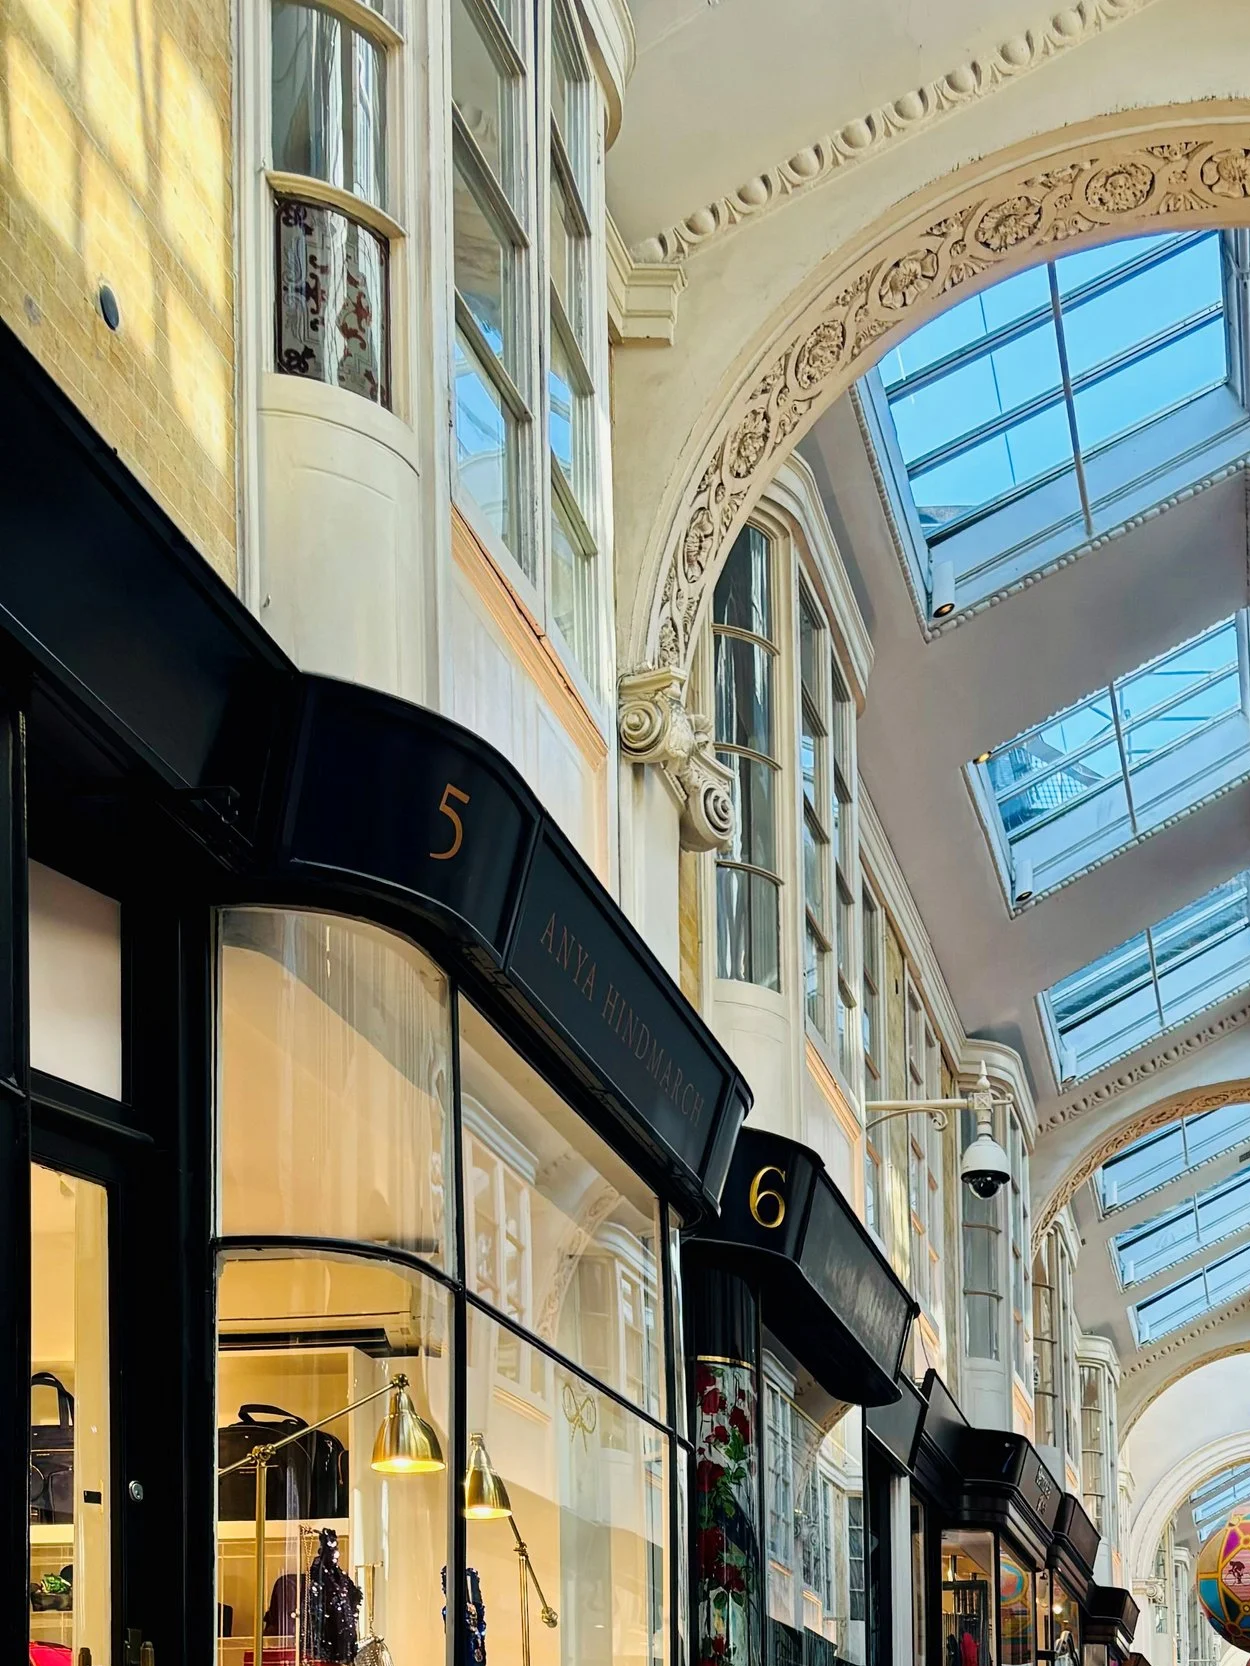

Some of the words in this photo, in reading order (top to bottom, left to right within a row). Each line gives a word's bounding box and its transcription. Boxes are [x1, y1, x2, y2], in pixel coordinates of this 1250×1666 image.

[429, 783, 470, 860] 5
[540, 912, 597, 1003] ANYA
[601, 983, 705, 1127] HINDMARCH
[749, 1166, 786, 1228] 6
